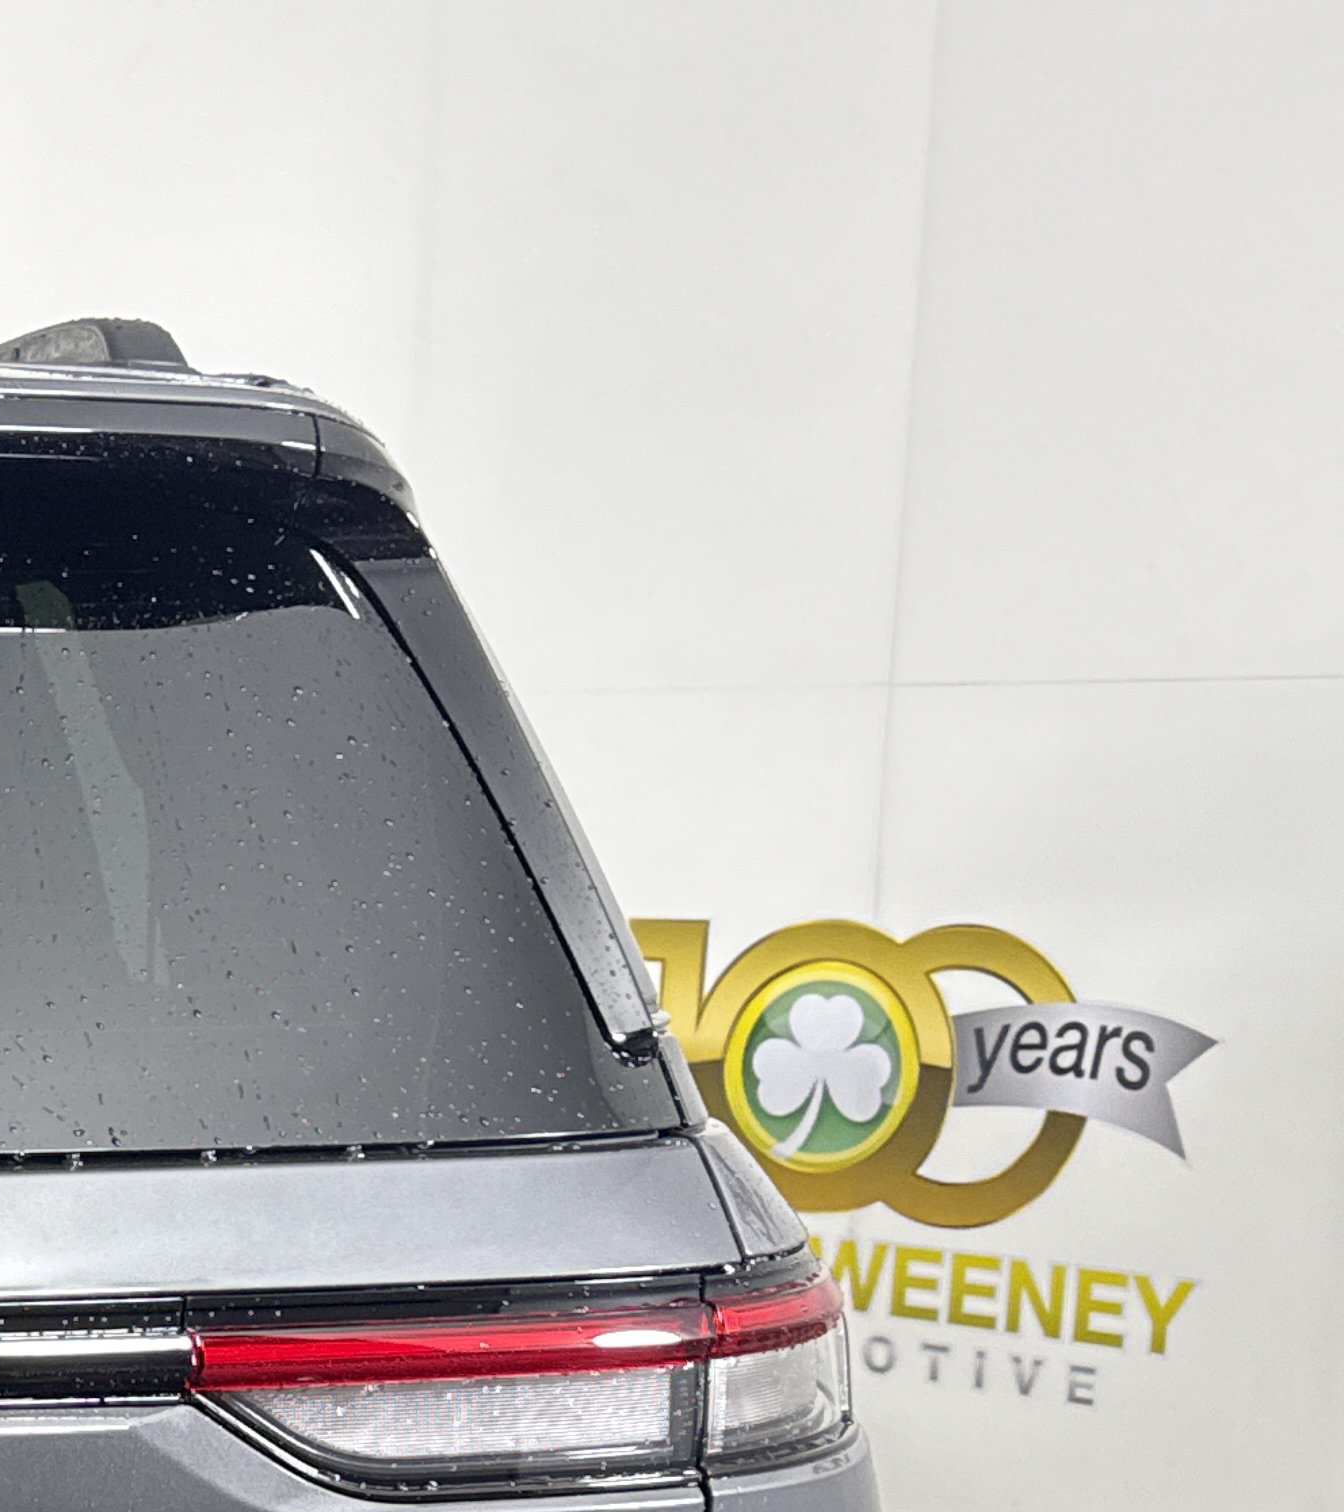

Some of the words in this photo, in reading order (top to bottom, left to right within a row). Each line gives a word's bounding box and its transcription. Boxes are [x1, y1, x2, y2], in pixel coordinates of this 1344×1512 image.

[965, 1020, 1157, 1094] years
[809, 1236, 1199, 1355] WEENEY
[863, 1336, 1098, 1406] OTIVE
